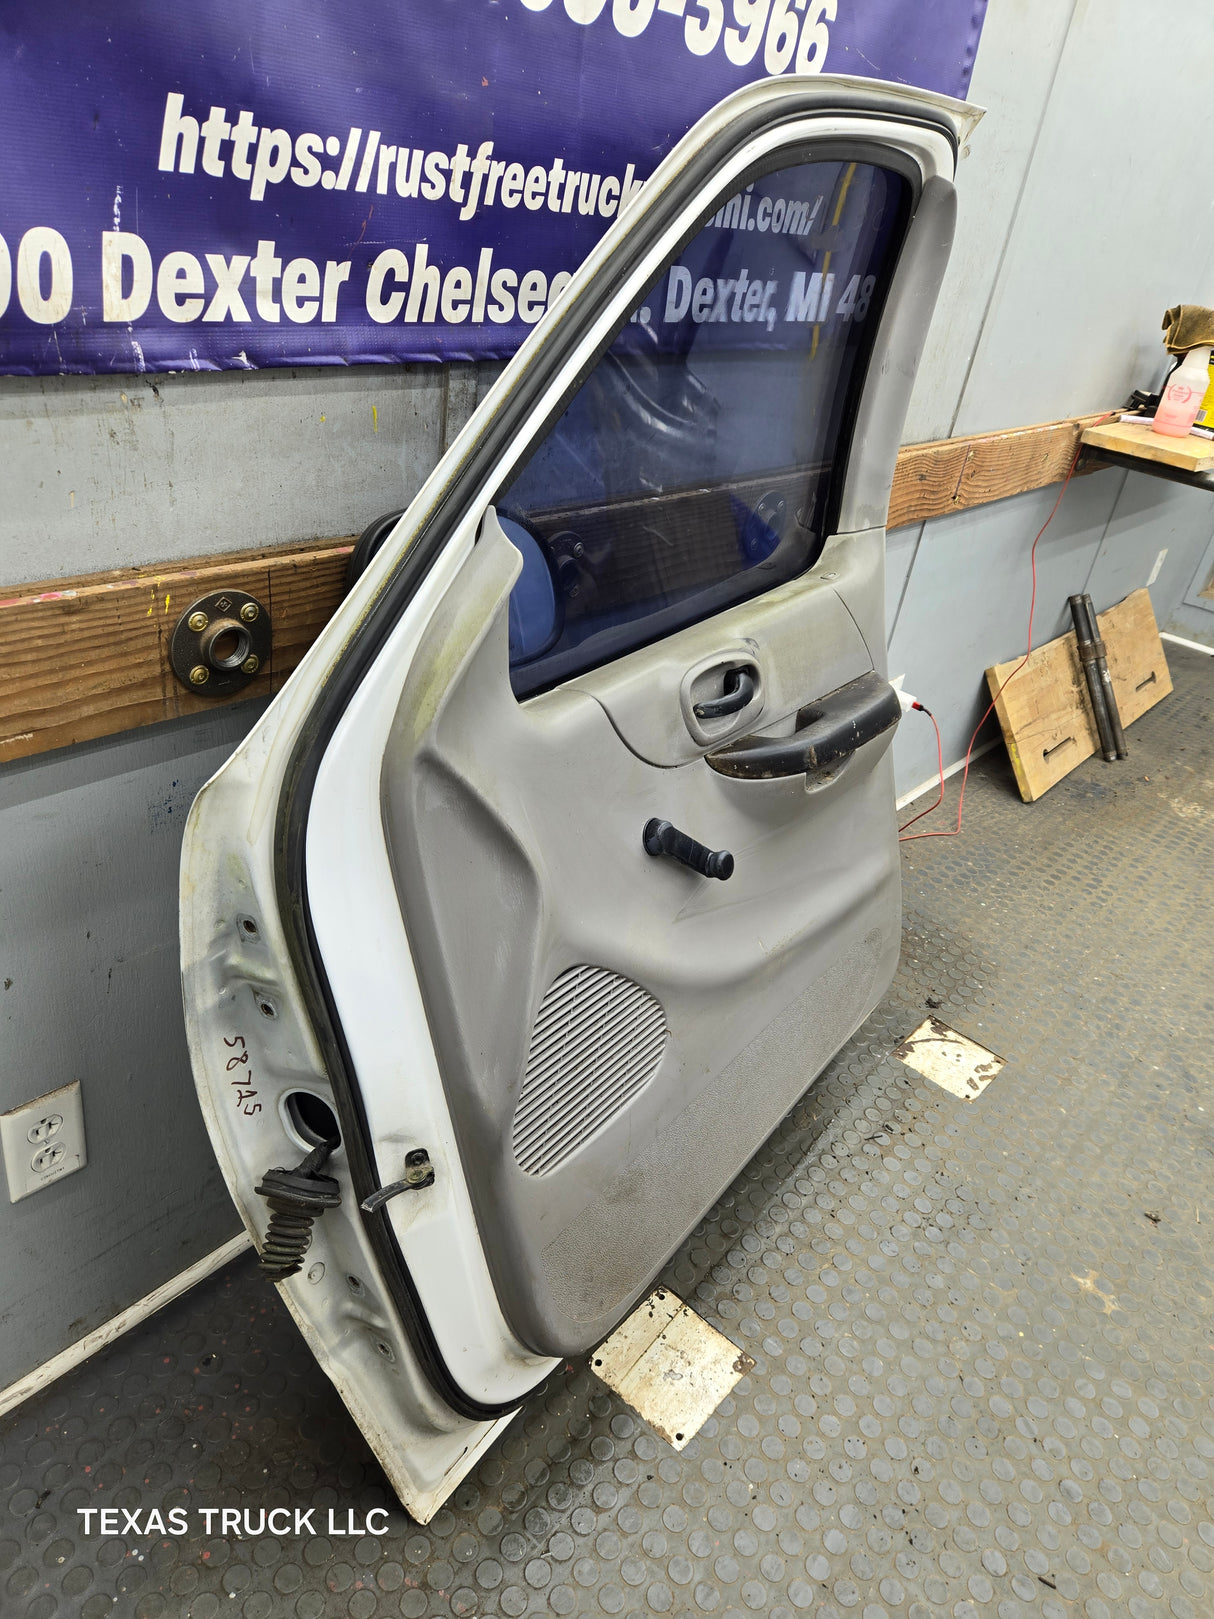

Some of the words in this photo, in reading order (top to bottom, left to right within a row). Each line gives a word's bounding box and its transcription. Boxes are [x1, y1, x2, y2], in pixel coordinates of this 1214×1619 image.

[519, 0, 838, 75] -3966
[102, 231, 351, 323] Dexter
[664, 265, 778, 332] Dexter,
[785, 271, 835, 322] MI
